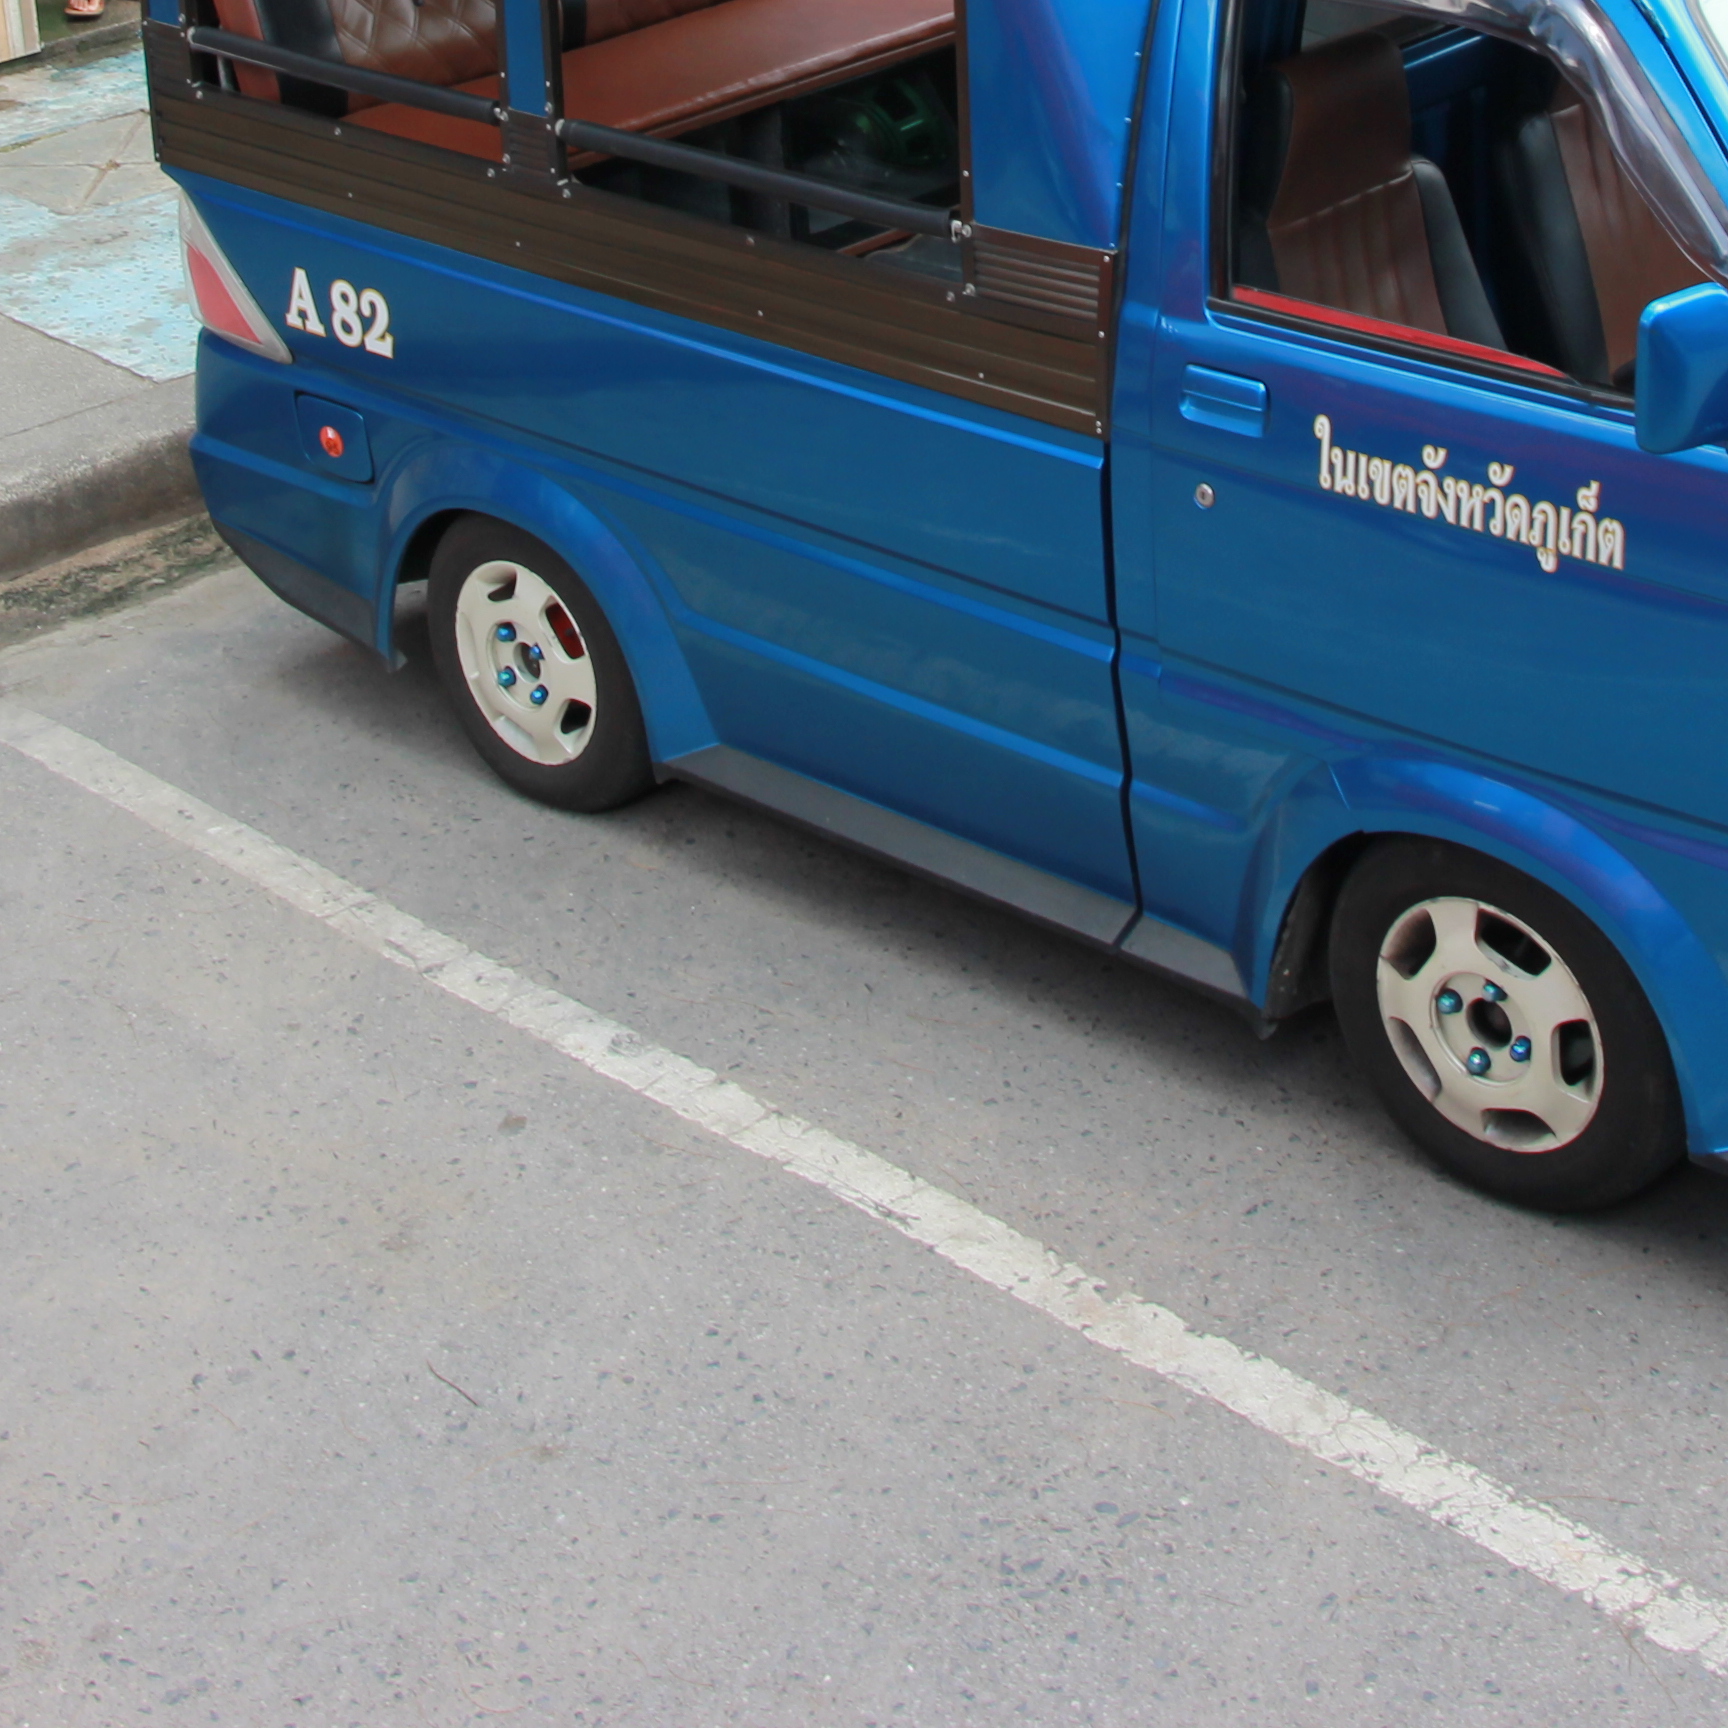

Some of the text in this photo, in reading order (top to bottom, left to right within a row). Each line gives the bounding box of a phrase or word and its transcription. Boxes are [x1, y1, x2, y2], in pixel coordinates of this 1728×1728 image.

[285, 266, 394, 359] A 82
[1313, 414, 1625, 573] ในเขตจังหวัดภูเก็ต
